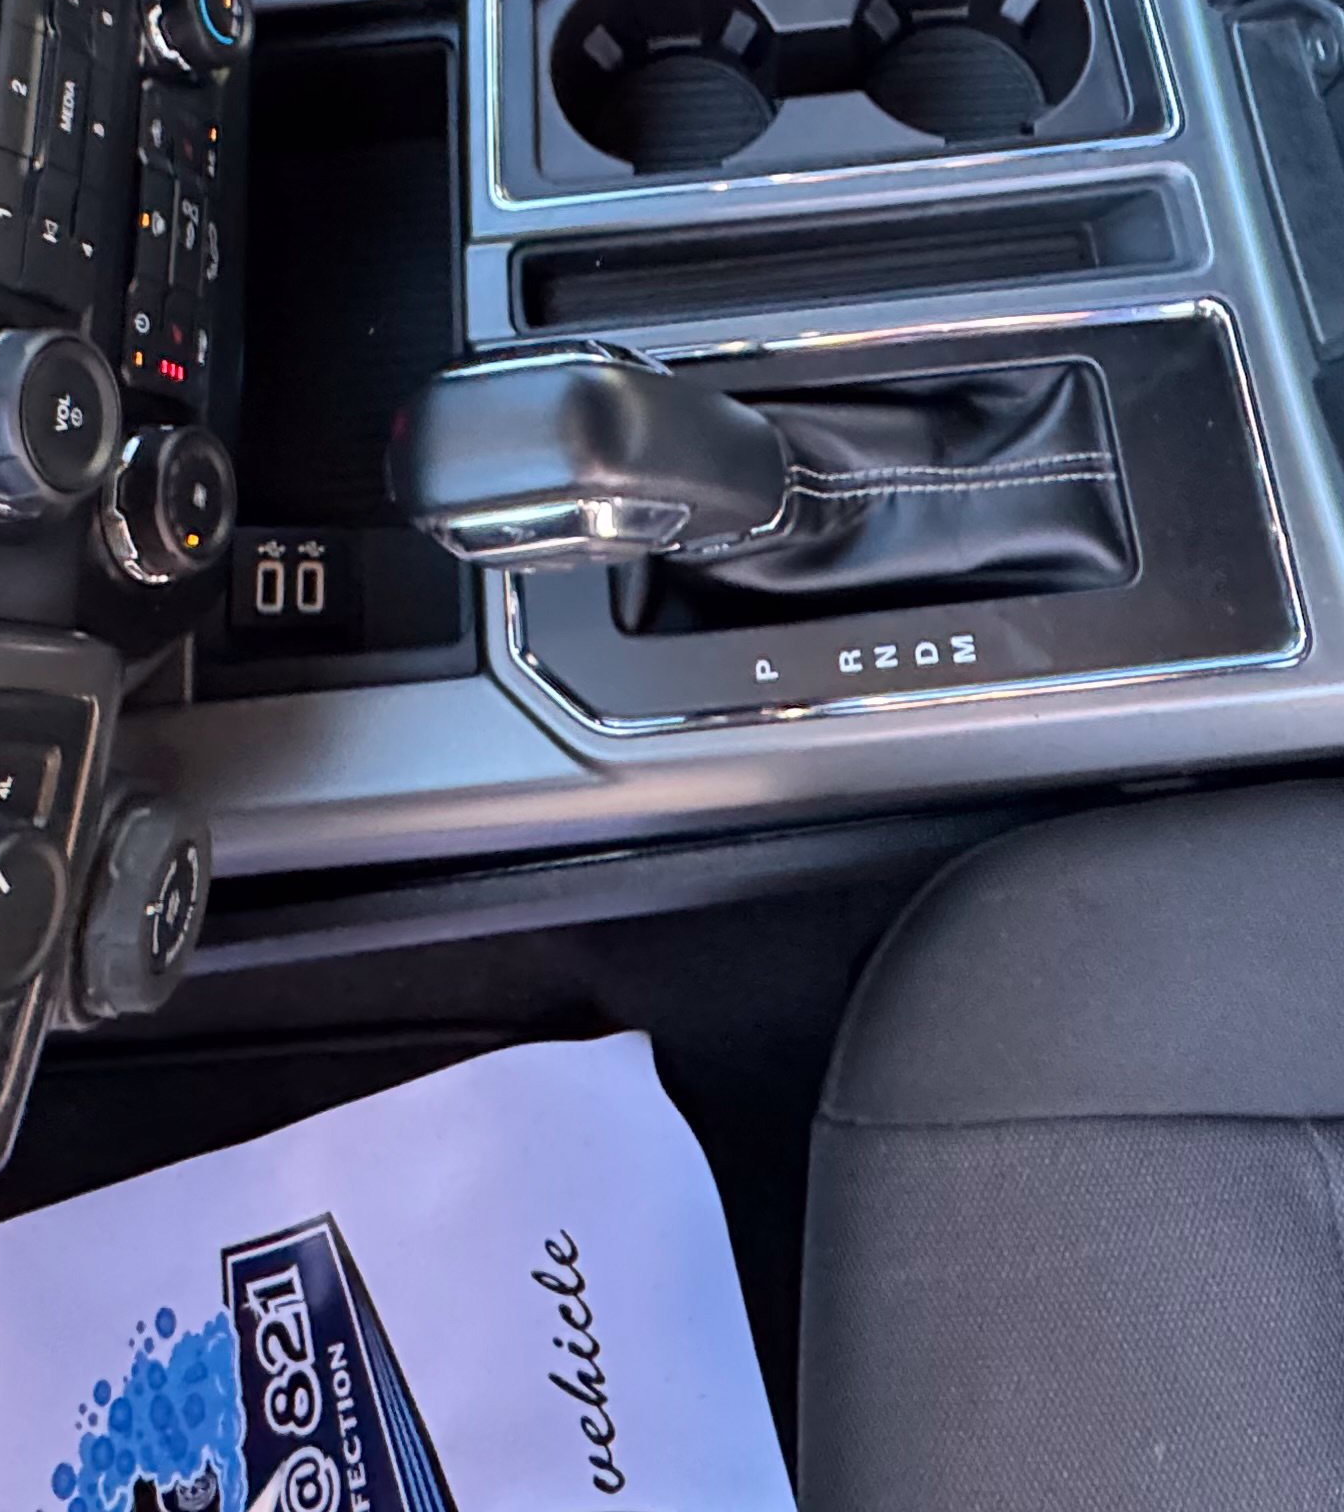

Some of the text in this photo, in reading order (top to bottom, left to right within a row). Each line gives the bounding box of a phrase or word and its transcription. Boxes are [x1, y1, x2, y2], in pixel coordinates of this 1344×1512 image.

[11, 79, 27, 97] 2
[60, 80, 75, 133] MEDIA
[54, 392, 71, 432] VOL
[839, 648, 864, 674] R
[874, 644, 899, 669] N
[914, 640, 941, 666] D
[952, 633, 977, 663] M
[756, 657, 779, 681] P
[244, 1265, 324, 1438] 821
[531, 1229, 627, 1495] vehicle
